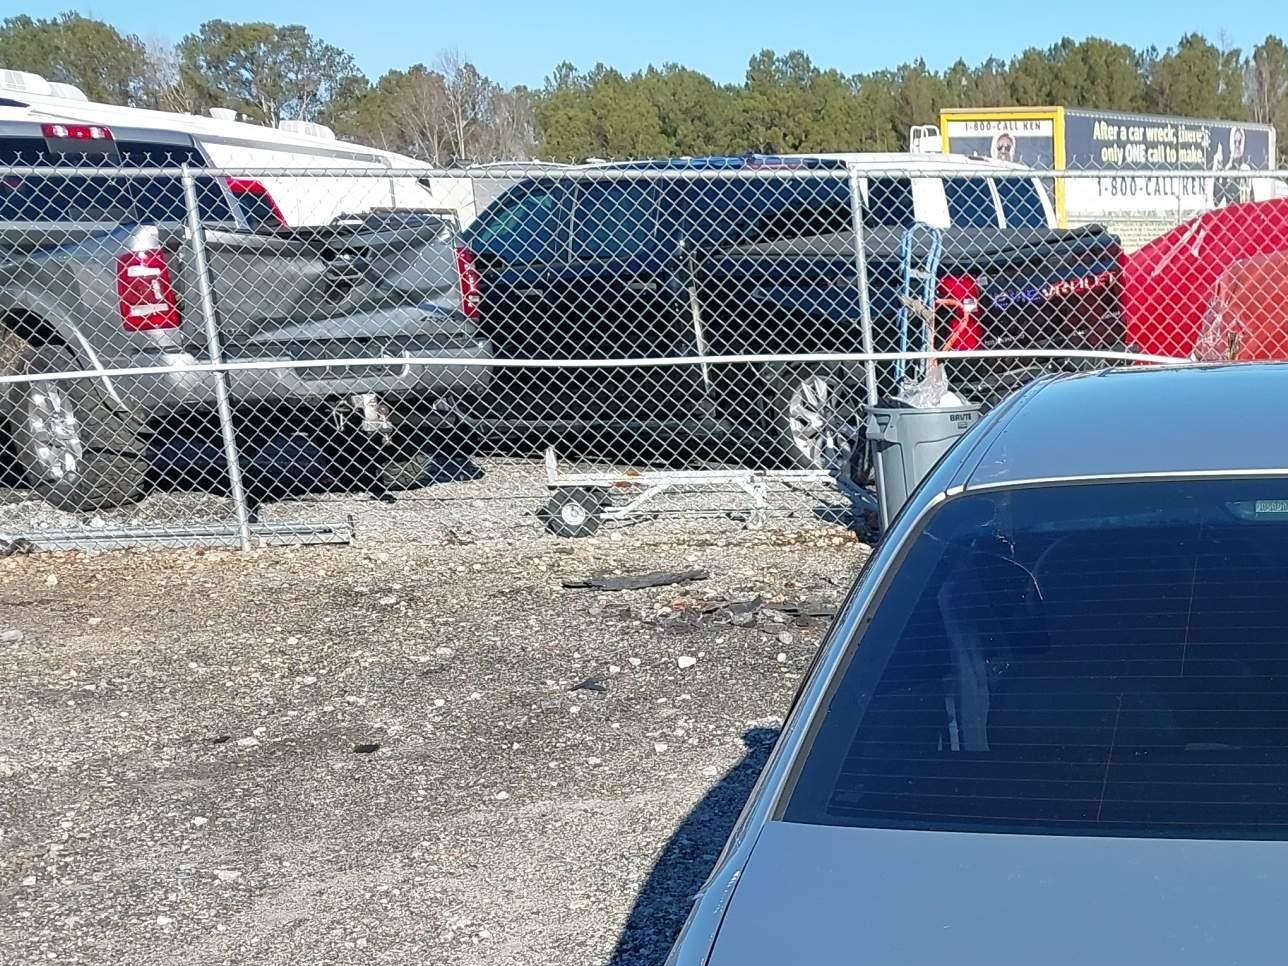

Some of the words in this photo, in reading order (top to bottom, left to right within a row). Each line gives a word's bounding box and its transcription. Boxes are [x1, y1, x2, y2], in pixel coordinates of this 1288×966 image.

[965, 121, 1019, 131] 1-800-CALL
[1023, 121, 1041, 131] KEN
[1093, 120, 1119, 140] After
[1120, 127, 1127, 140] a
[1128, 127, 1145, 141] car
[1146, 123, 1177, 144] wreck,
[1101, 143, 1123, 166] only
[1125, 143, 1146, 162] ONE
[1147, 143, 1165, 162] call
[1166, 145, 1178, 163] to
[1097, 176, 1176, 197] 1-800-CALL
[1182, 176, 1206, 196] KEN
